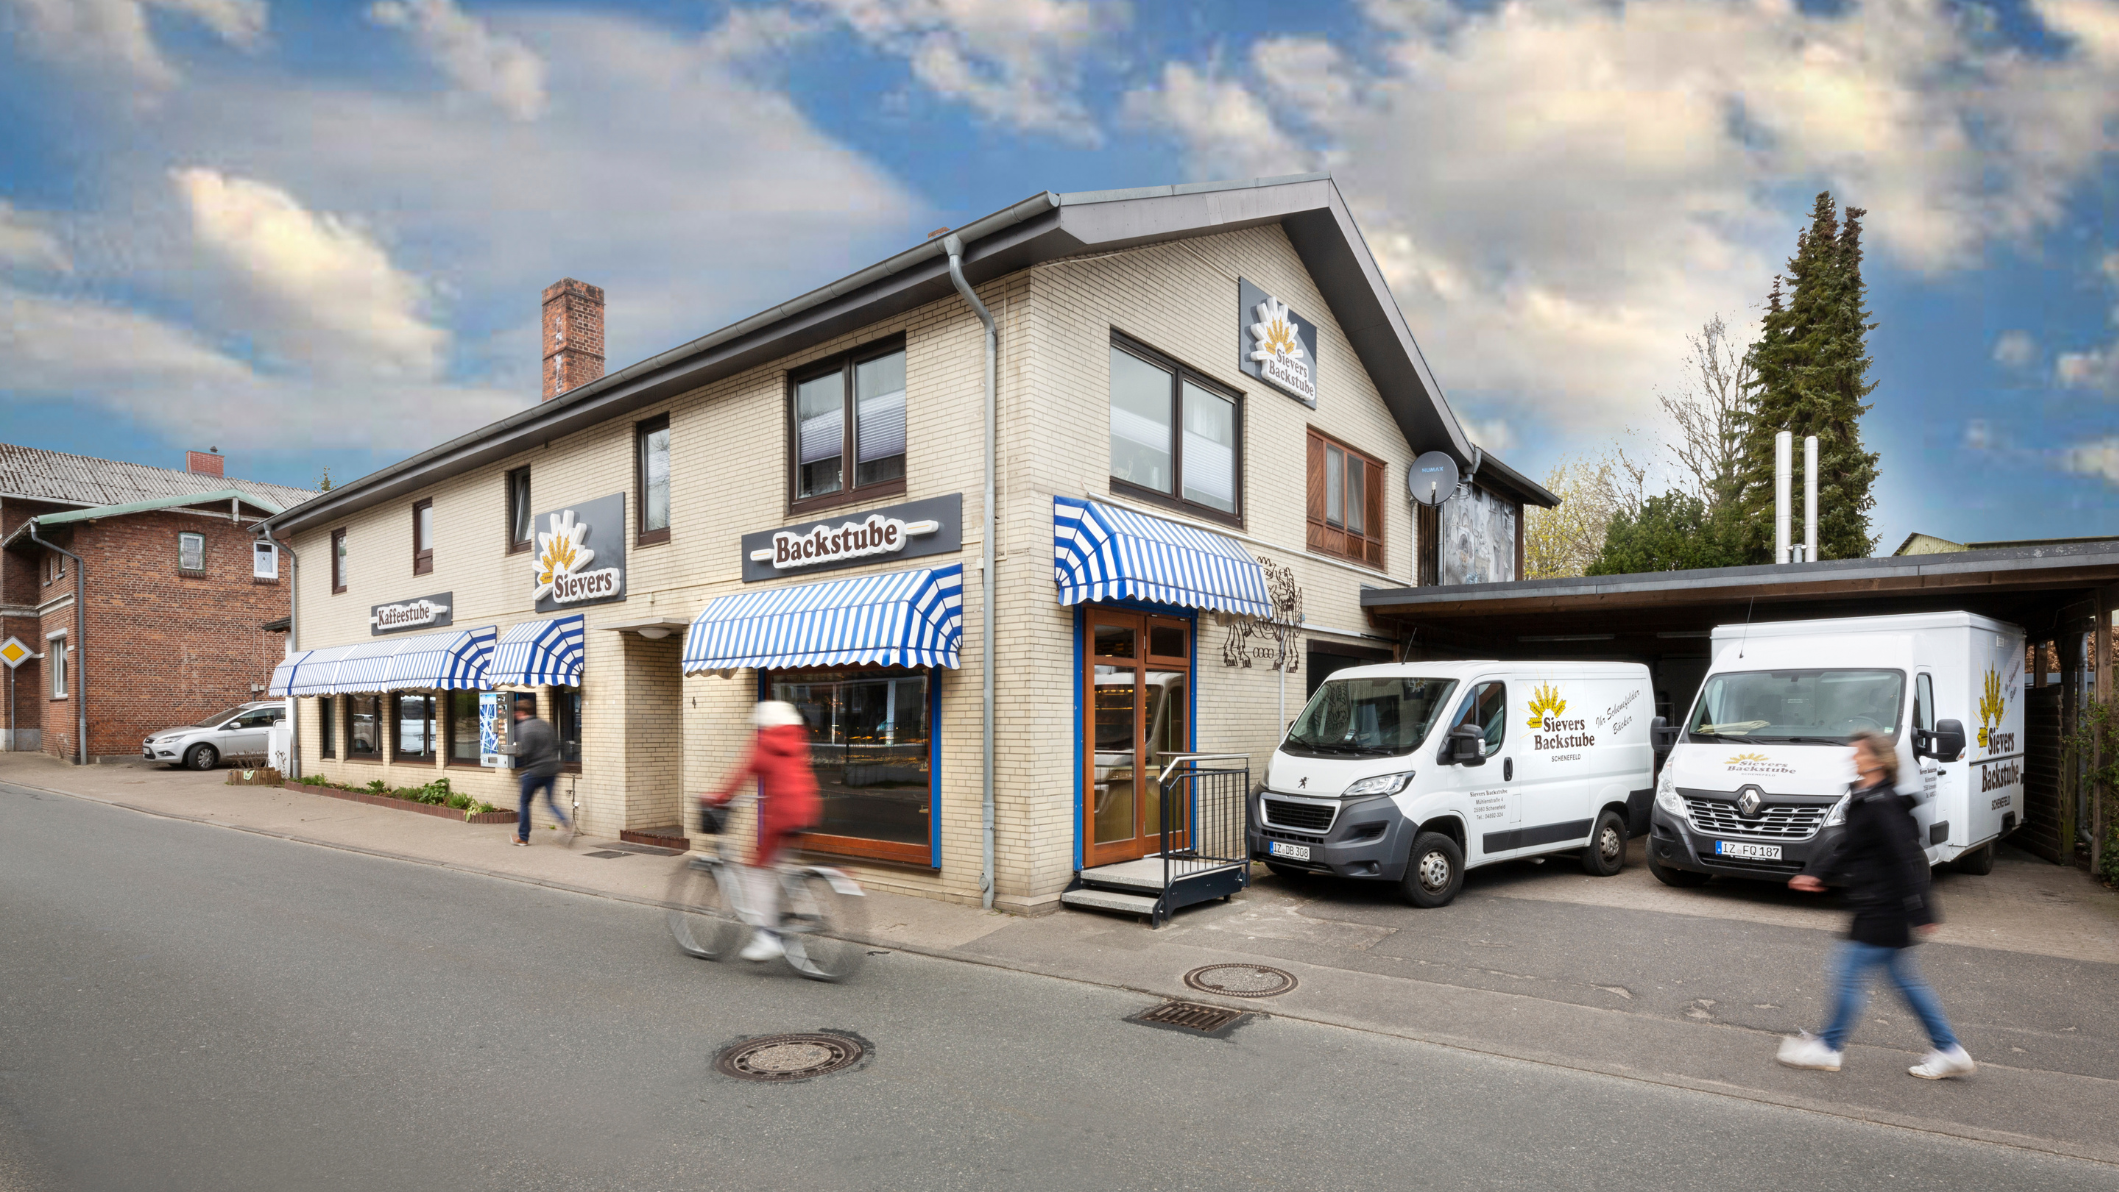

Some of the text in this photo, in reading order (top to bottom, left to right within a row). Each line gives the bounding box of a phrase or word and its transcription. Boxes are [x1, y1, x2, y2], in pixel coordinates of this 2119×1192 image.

[1276, 348, 1308, 378] Sievers
[1269, 359, 1314, 397] Backstube
[776, 519, 898, 563] Backstube
[554, 572, 613, 599] Sievers
[378, 603, 430, 627] Kaffeestube
[1543, 717, 1585, 732] Sievers
[1534, 732, 1595, 750] Backstube
[1988, 727, 2015, 755] Sievers
[1551, 753, 1581, 762] SCHENEFELD
[1727, 765, 1796, 774] Backstube
[1981, 759, 2019, 793] Backstube
[1723, 843, 1736, 854] IZ
[1742, 845, 1757, 856] FQ
[1759, 846, 1780, 858] 187
